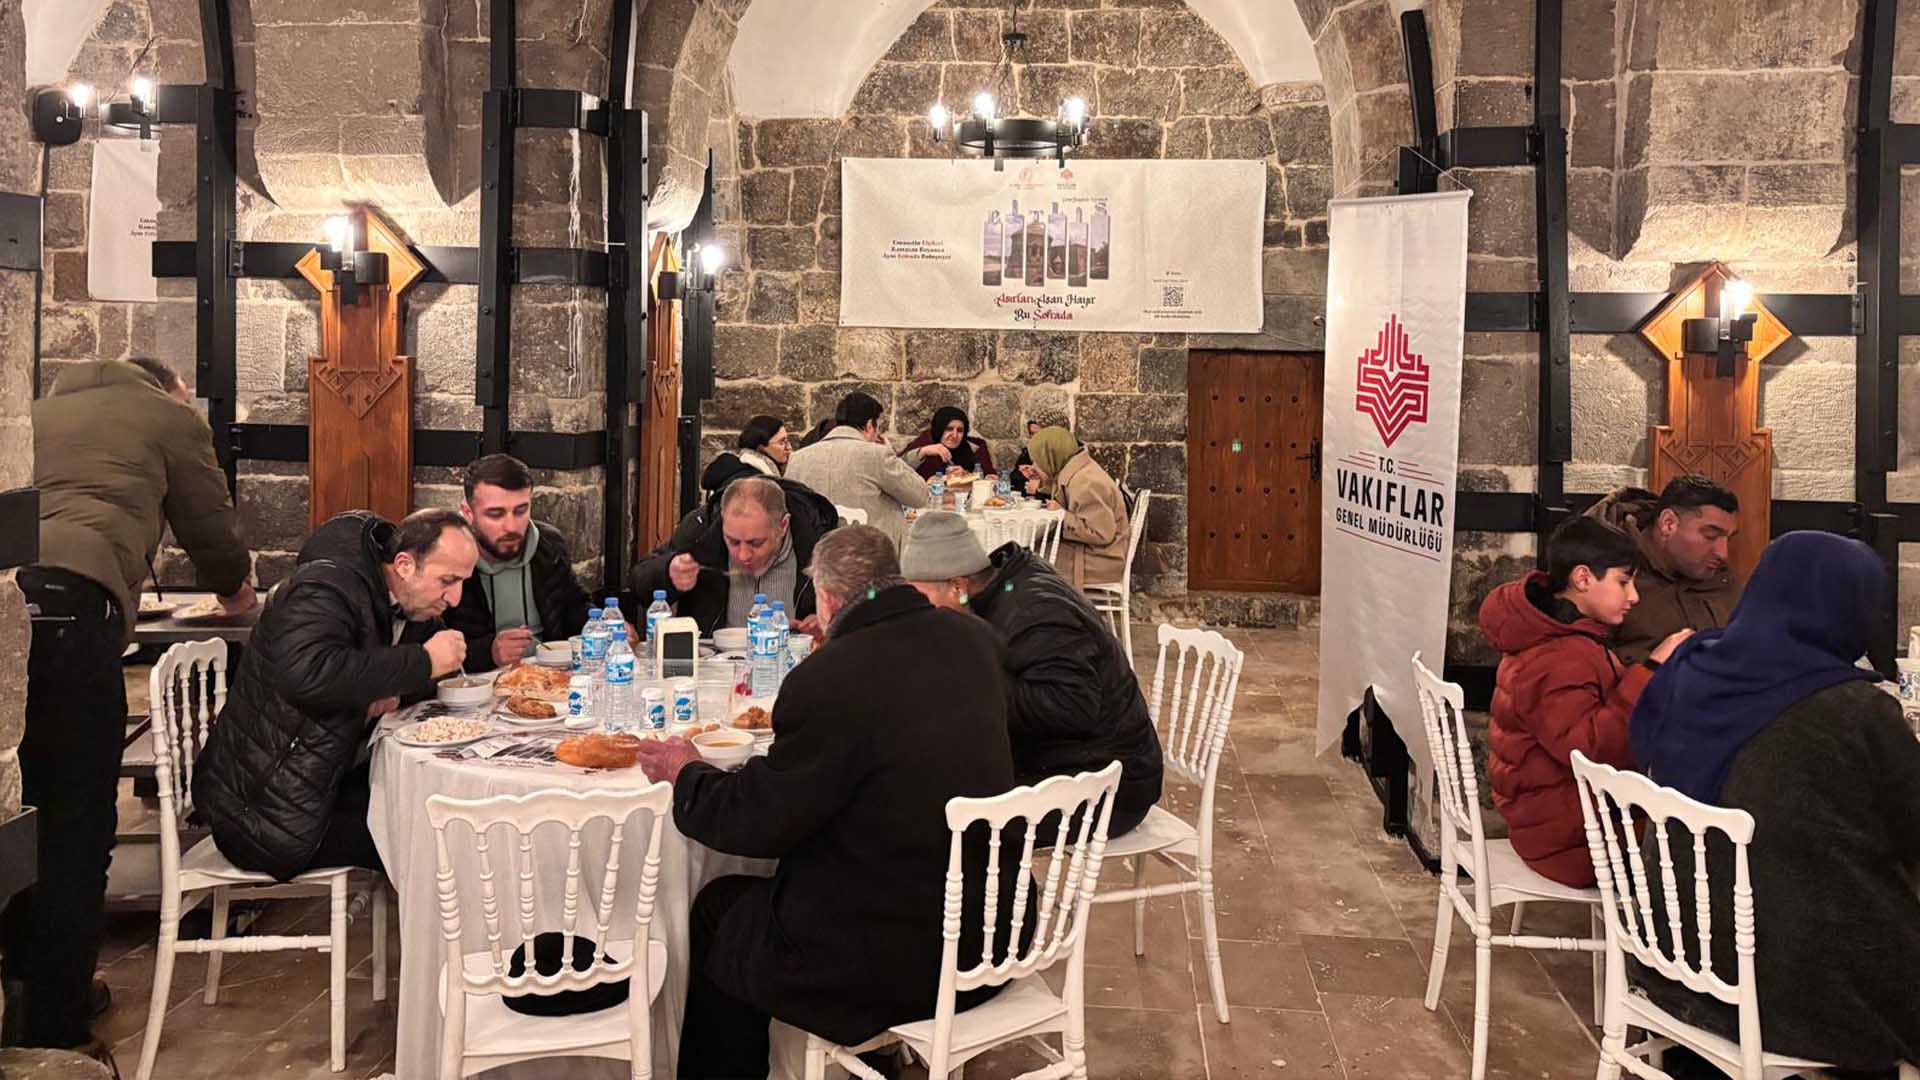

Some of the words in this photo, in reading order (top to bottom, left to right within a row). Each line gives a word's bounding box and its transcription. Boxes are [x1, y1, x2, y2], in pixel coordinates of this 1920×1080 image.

[1014, 308, 1030, 321] Bu
[1033, 309, 1073, 321] Sofrada
[1379, 456, 1396, 475] T.C.
[1337, 468, 1444, 527] VAKIFLAR
[1336, 507, 1364, 530] GENEL
[1368, 516, 1442, 553] MÜDÜRLÜĞÜ
